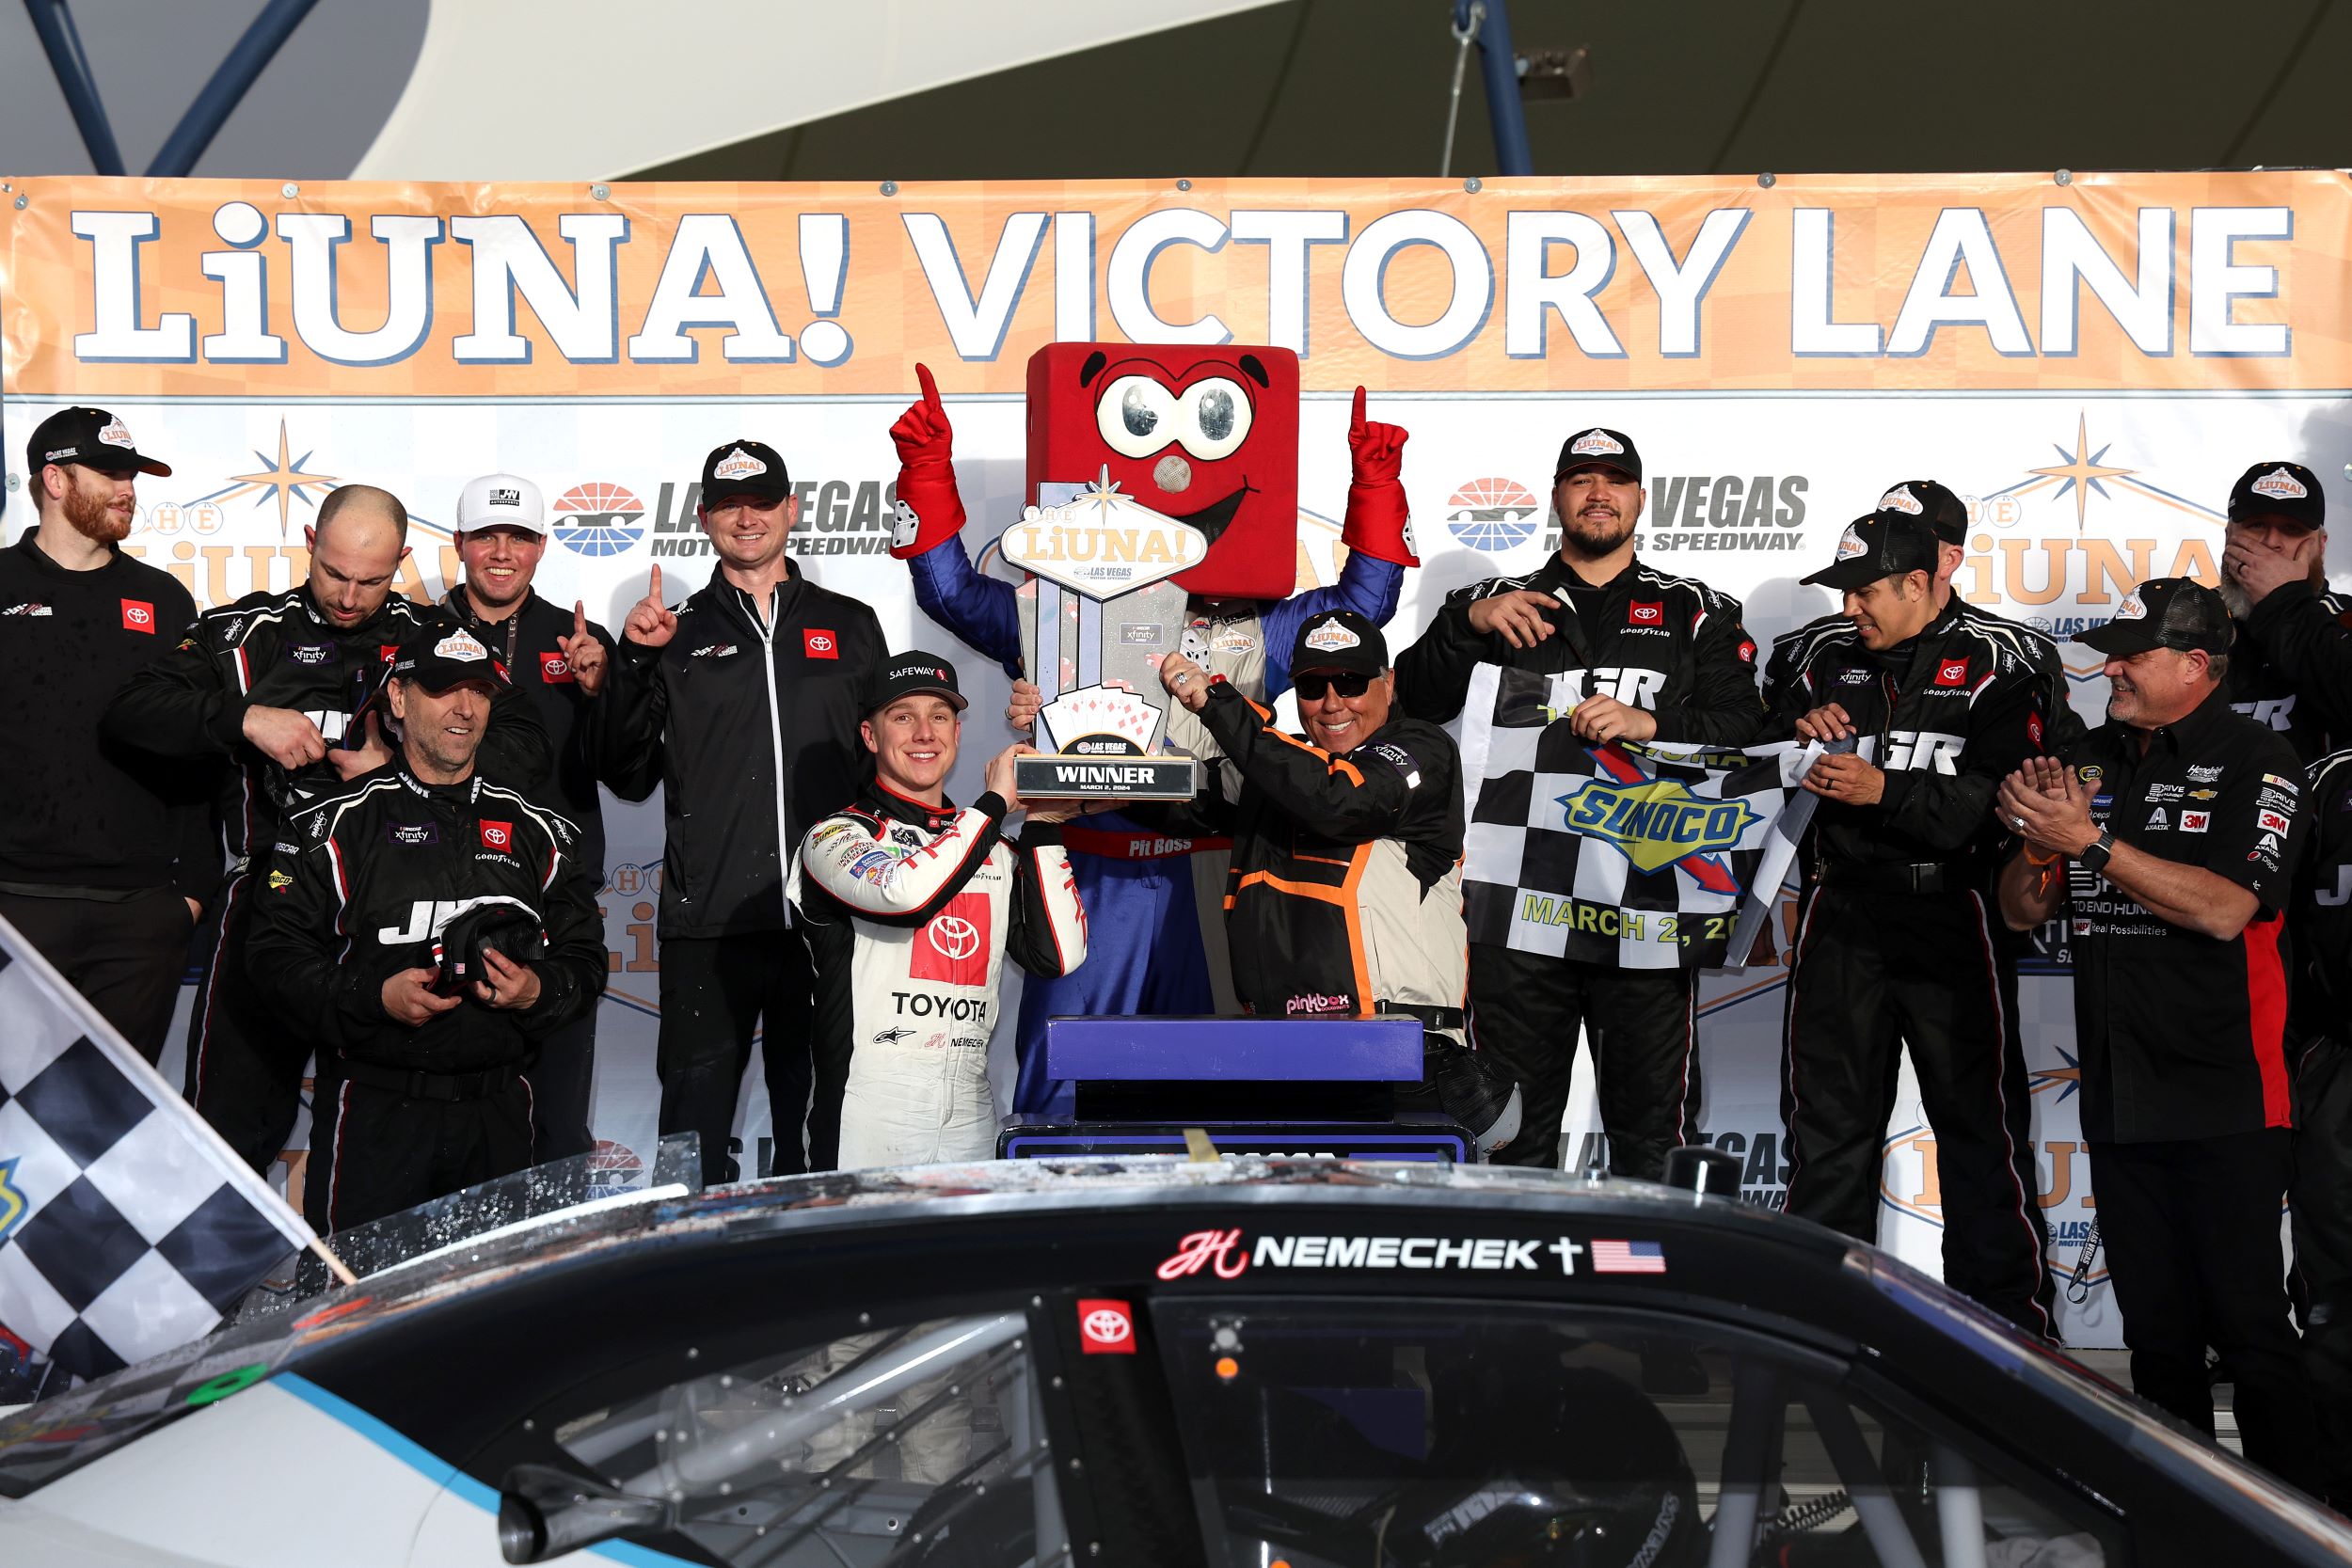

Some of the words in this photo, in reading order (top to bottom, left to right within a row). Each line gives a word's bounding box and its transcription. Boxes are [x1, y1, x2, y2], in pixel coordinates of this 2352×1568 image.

[71, 201, 853, 367] LiUNA!
[901, 207, 1754, 361] VICTORY
[1791, 206, 2294, 358] LANE
[654, 482, 703, 533] LA
[1651, 475, 1809, 528] VEGAS
[651, 538, 721, 557] MOT
[783, 537, 895, 556] PEEDWA
[1022, 525, 1187, 564] LiUNA!
[1651, 532, 1799, 552] SPEEDWAY
[1090, 567, 1105, 577] LAS
[1106, 567, 1132, 578] VEGAS
[224, 617, 243, 641] IMPACT
[1127, 630, 1155, 640] xfinity
[1620, 626, 1670, 638] GOODYEAR
[2055, 617, 2086, 635] LAS
[293, 651, 326, 664] xfinity
[1788, 639, 1804, 663] IMPACT
[889, 666, 935, 680] SAFEWAY
[1839, 673, 1872, 684] xfinity
[1923, 689, 1971, 698] GOODYEAR
[1091, 742, 1104, 751] LAS
[1104, 742, 1126, 751] VEGAS
[1373, 746, 1407, 766] xfinity
[1056, 766, 1155, 784] WINNER
[2150, 784, 2185, 794] DRIVE
[1572, 788, 1740, 844] SUNOCO
[2091, 811, 2111, 819] pepsi
[2184, 814, 2207, 830] 3M
[2262, 814, 2286, 833] 3M
[310, 811, 326, 838] IMPACT
[395, 831, 429, 841] xfinity
[1129, 839, 1151, 857] Pit
[2254, 845, 2280, 859] AXALTA
[475, 853, 520, 868] GOODYEAR
[2262, 855, 2279, 872] pepsi
[2073, 900, 2086, 912] TO
[2087, 901, 2111, 914] END
[1521, 895, 1645, 942] MARCH
[1658, 917, 1691, 947] 2,
[2091, 924, 2108, 933] Real
[2110, 924, 2168, 936] Possibilities
[891, 991, 987, 1022] TOYOTA
[1286, 992, 1350, 1015] pinkbox
[2059, 1222, 2090, 1240] LAS
[1252, 1235, 1545, 1271] NEMECHEK
